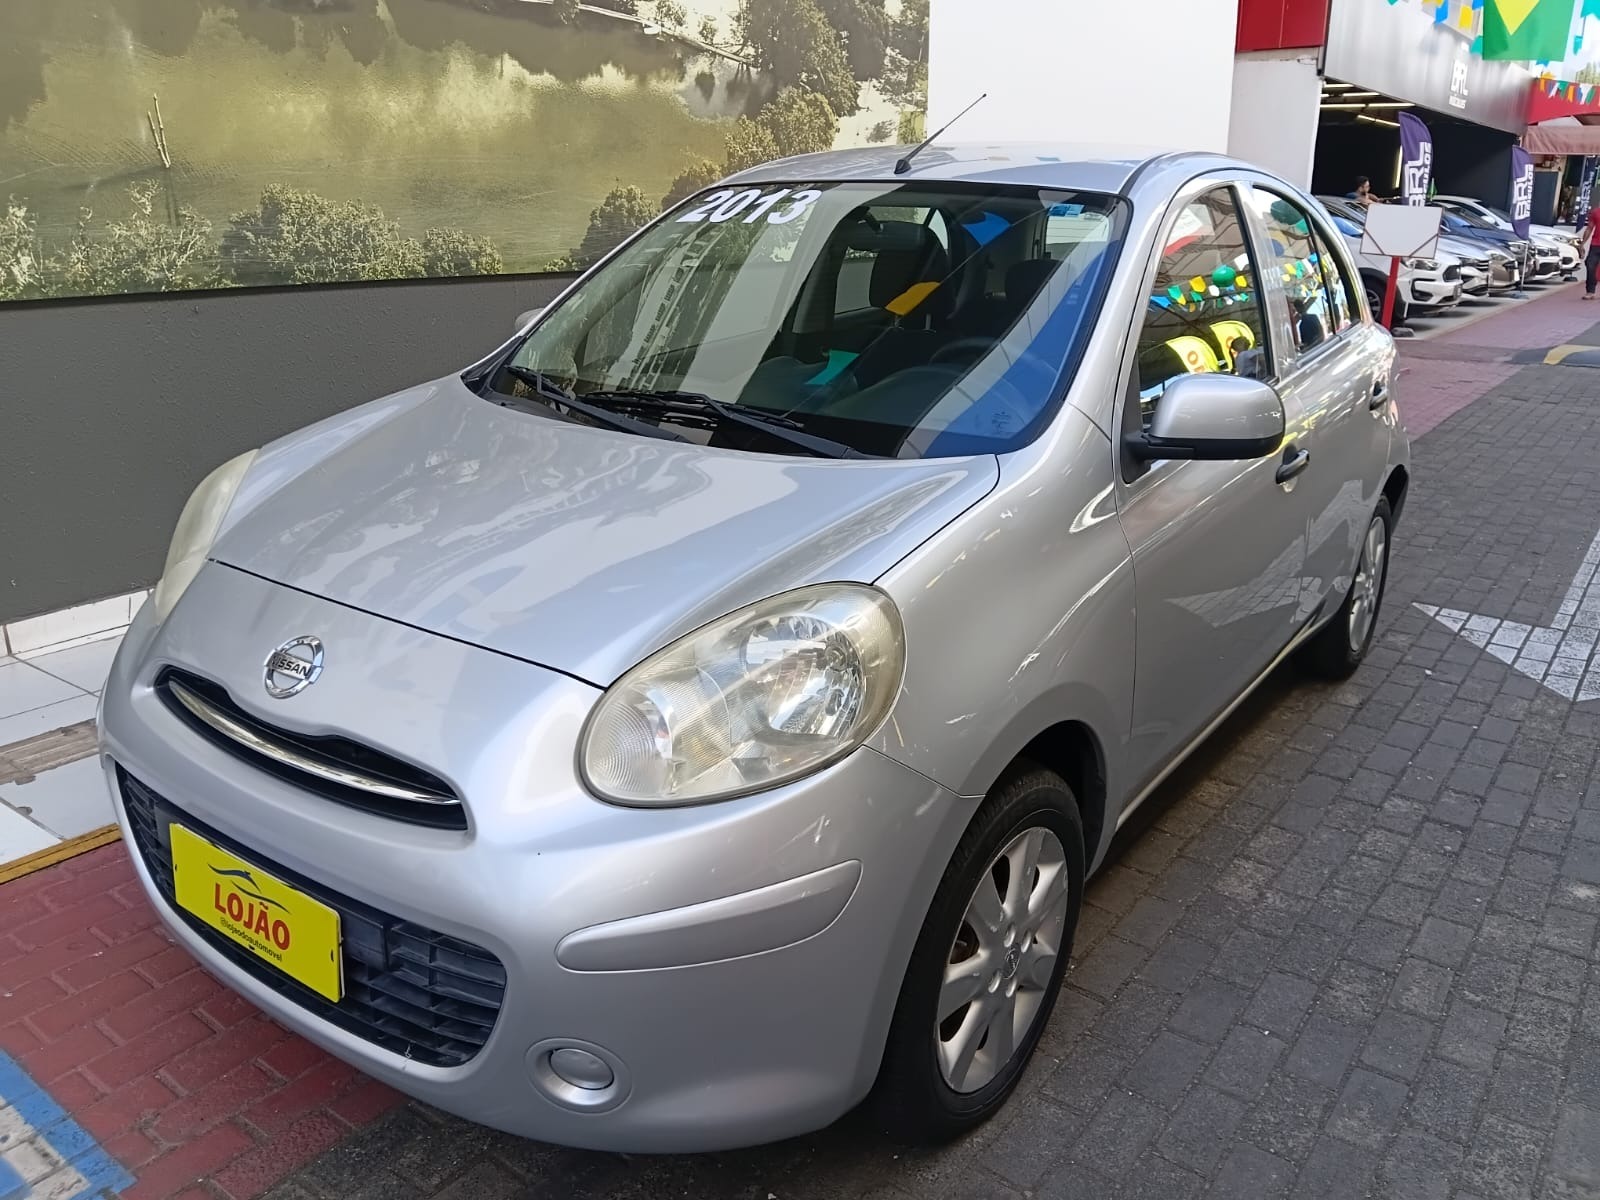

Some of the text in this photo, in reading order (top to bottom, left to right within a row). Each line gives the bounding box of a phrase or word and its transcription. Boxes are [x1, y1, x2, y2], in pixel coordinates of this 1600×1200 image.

[675, 188, 822, 224] 2013
[1513, 164, 1529, 220] BRL
[272, 655, 312, 678] NISSAN
[214, 882, 290, 951] LOJÃO
